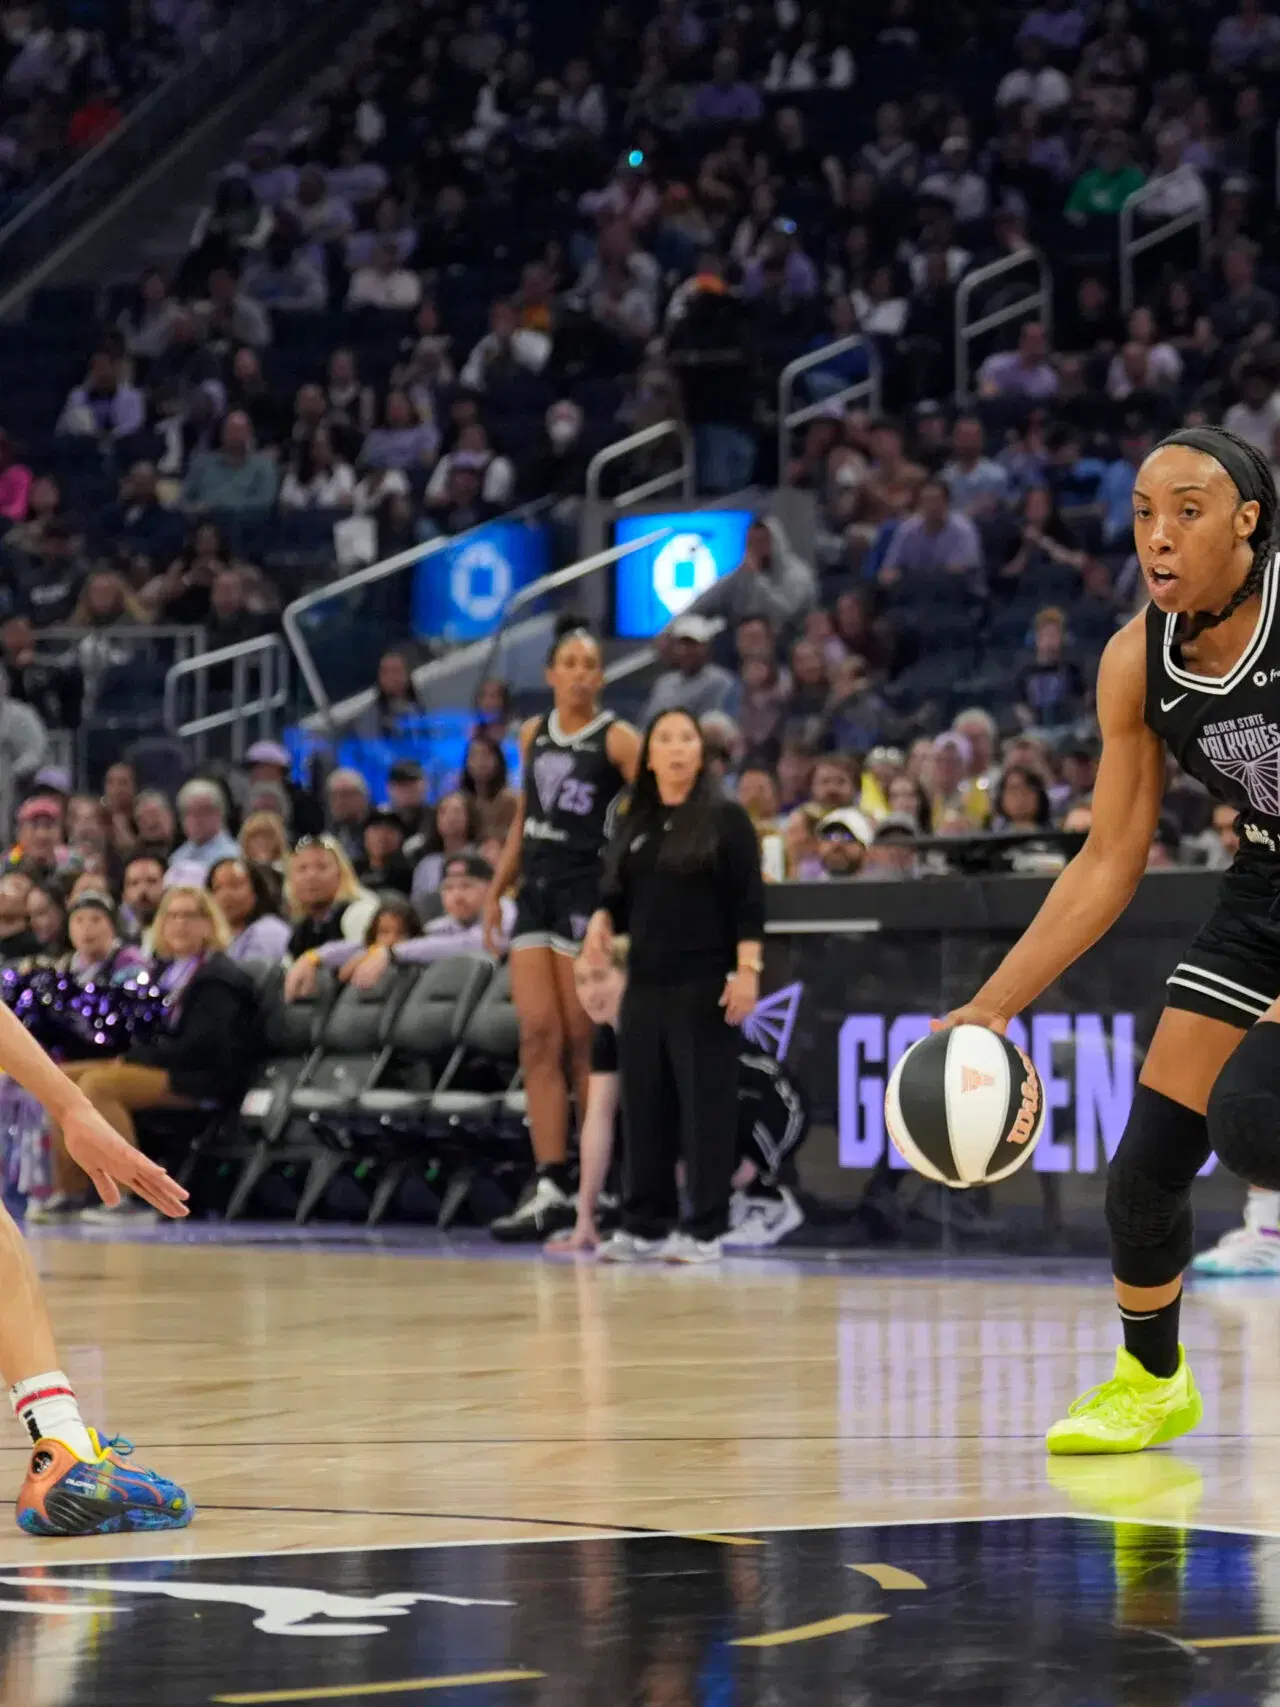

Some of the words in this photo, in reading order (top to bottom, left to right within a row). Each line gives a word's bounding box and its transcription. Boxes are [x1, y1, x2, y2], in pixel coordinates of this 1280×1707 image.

[1203, 719, 1237, 736] GOLDEN
[1237, 713, 1265, 729] STATE
[558, 779, 596, 815] 25
[837, 1013, 1135, 1174] GEN
